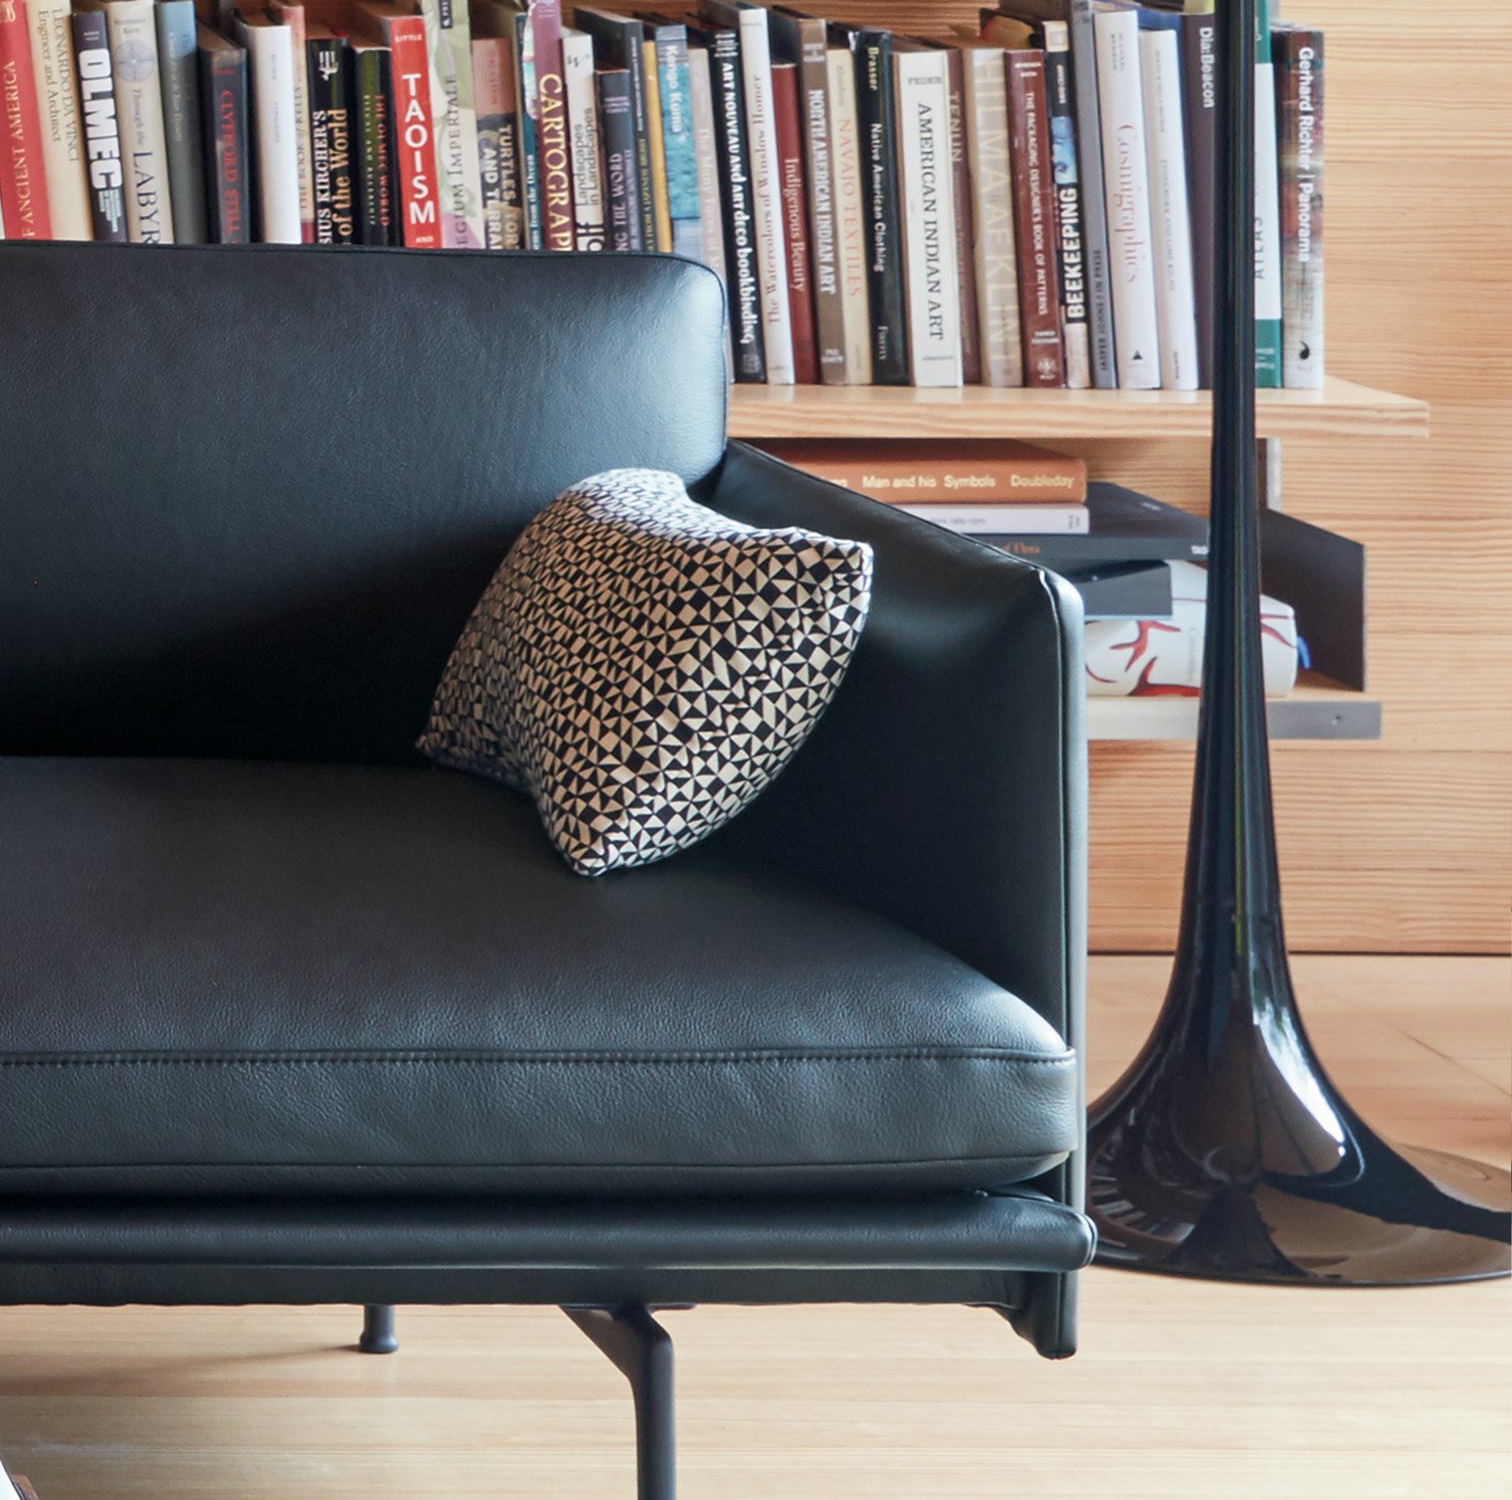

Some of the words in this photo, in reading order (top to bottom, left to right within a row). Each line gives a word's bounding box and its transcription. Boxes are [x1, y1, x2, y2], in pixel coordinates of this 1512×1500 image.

[1199, 27, 1215, 108] Dia:Beacon
[1297, 47, 1315, 111] Gerhard
[79, 48, 122, 189] OLMEC
[1298, 115, 1315, 171] Richter
[918, 103, 937, 213] AMERICAN
[925, 219, 941, 293] INDIAN
[1298, 183, 1313, 261] Panorama
[927, 298, 943, 340] ART
